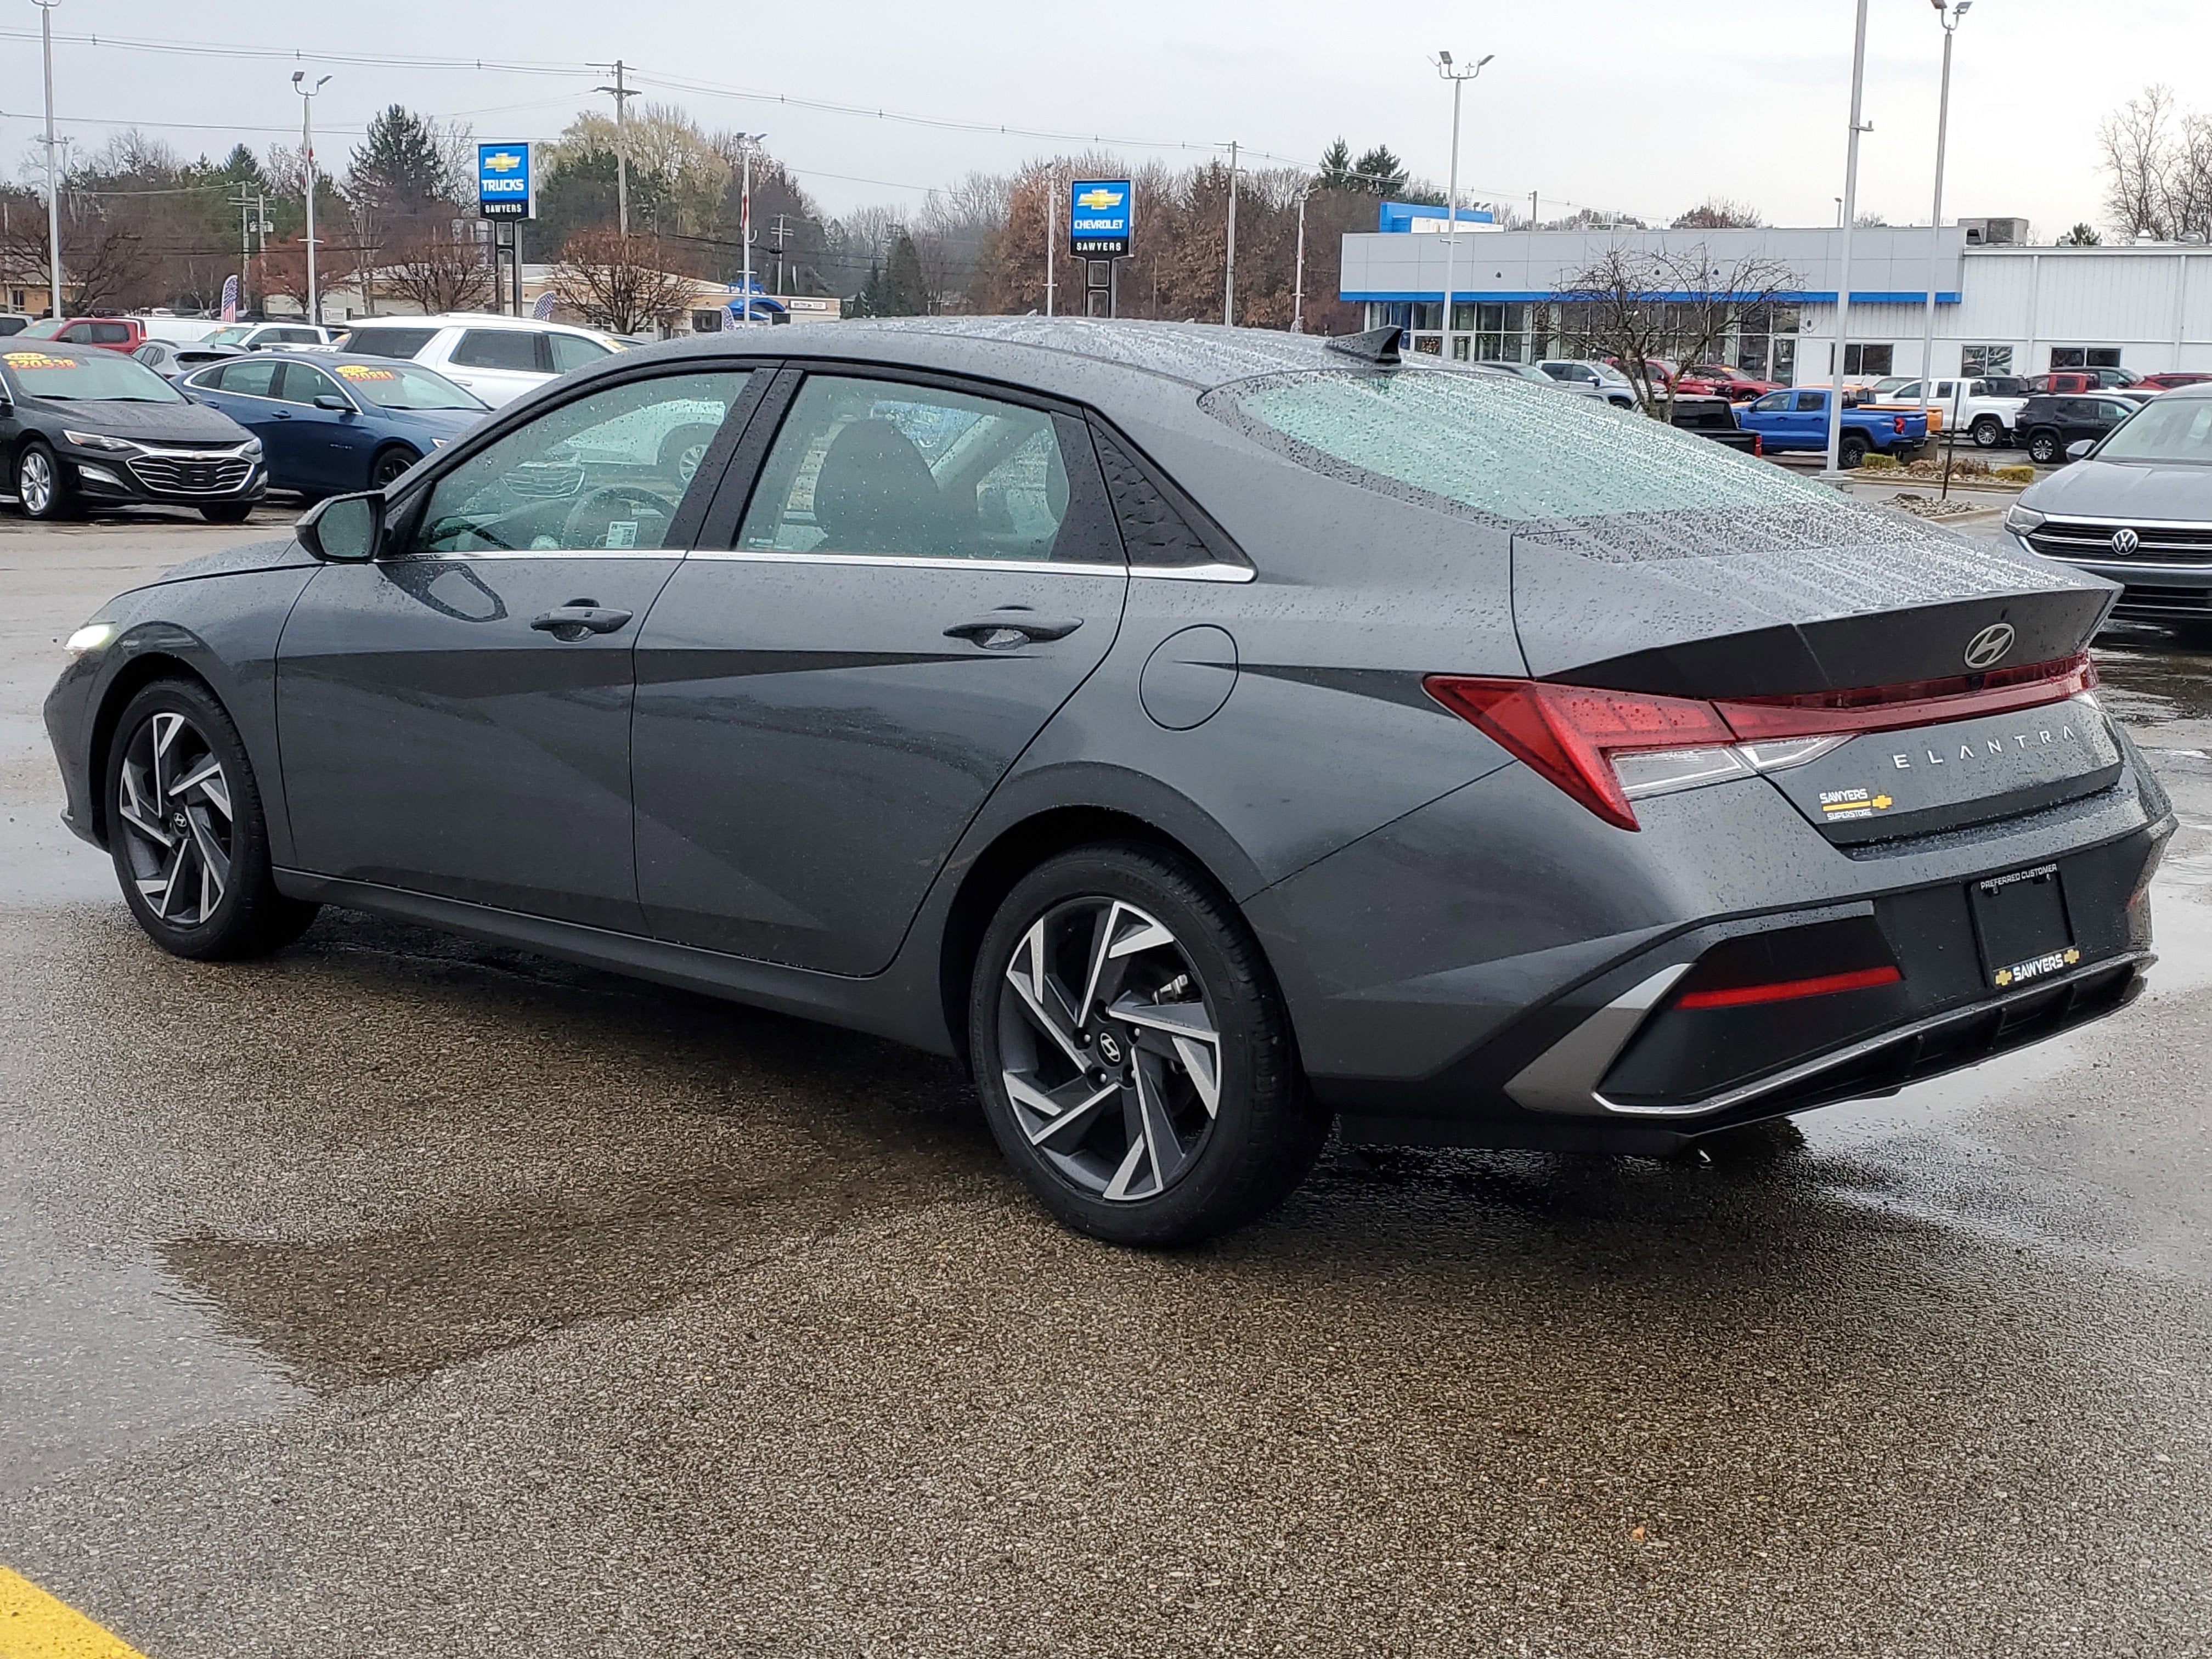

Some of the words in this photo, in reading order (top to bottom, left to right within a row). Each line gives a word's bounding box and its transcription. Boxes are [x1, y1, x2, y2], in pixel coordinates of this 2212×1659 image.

[481, 179, 524, 191] TRUCKS
[485, 204, 522, 213] SAWYERS
[1074, 219, 1124, 229] CHEVROLET
[1076, 242, 1122, 251] SAWYERS
[1892, 725, 2075, 769] ELANTRA
[1819, 788, 1868, 804] SAWYERS
[1826, 808, 1873, 821] SUPERSTORE
[1980, 872, 2021, 890] PREFERRED
[2021, 863, 2057, 879] CUSTOMER
[2012, 952, 2064, 982] SAWYERS
